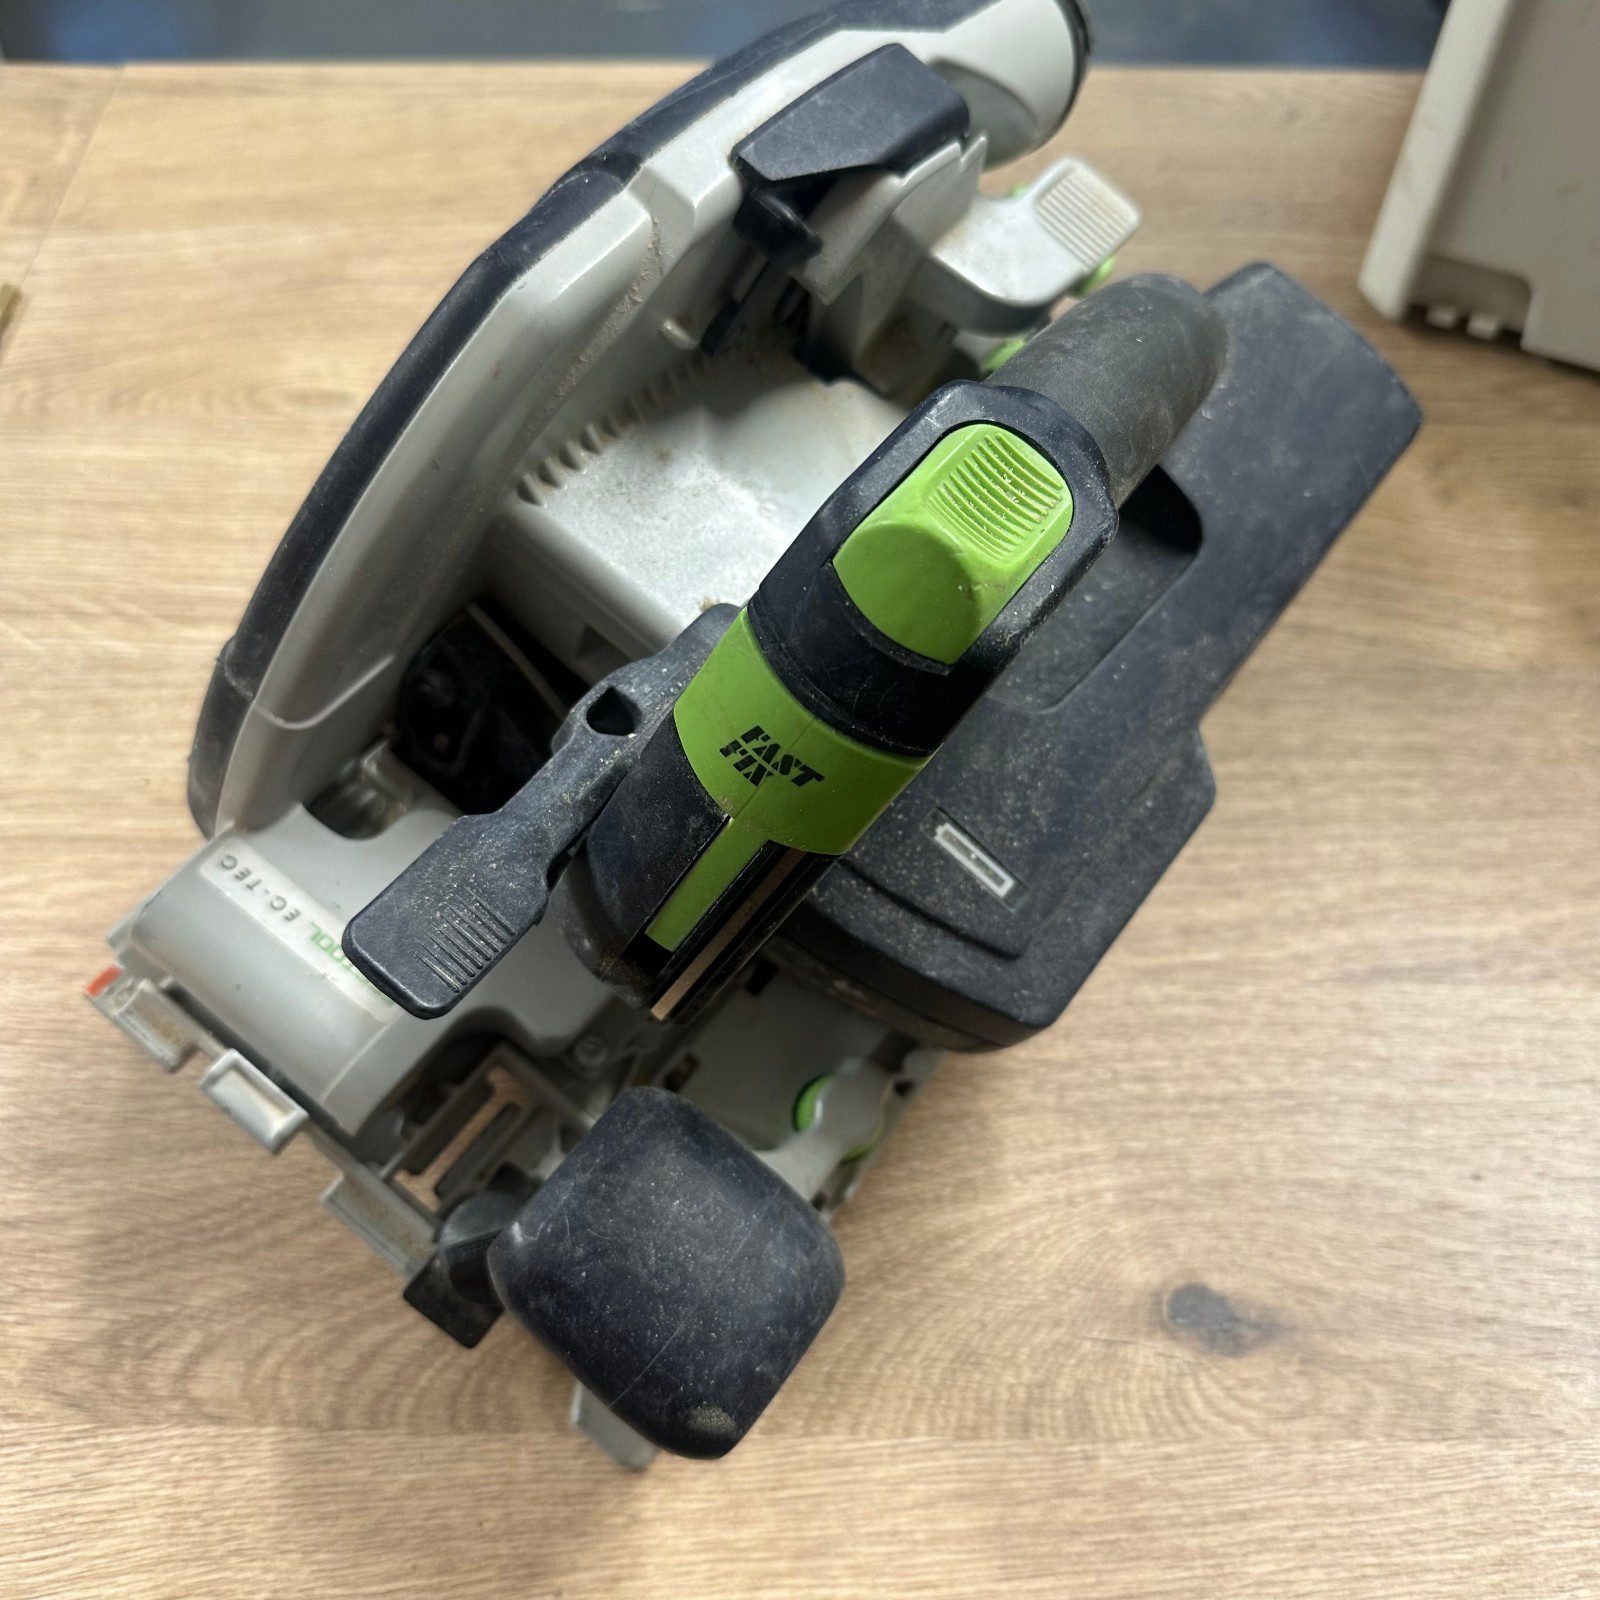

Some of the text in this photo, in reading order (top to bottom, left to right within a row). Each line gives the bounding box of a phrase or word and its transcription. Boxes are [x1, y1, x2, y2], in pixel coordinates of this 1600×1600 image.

[718, 739, 774, 788] FIX
[741, 726, 826, 787] FAST
[220, 854, 302, 922] EC-TEC
